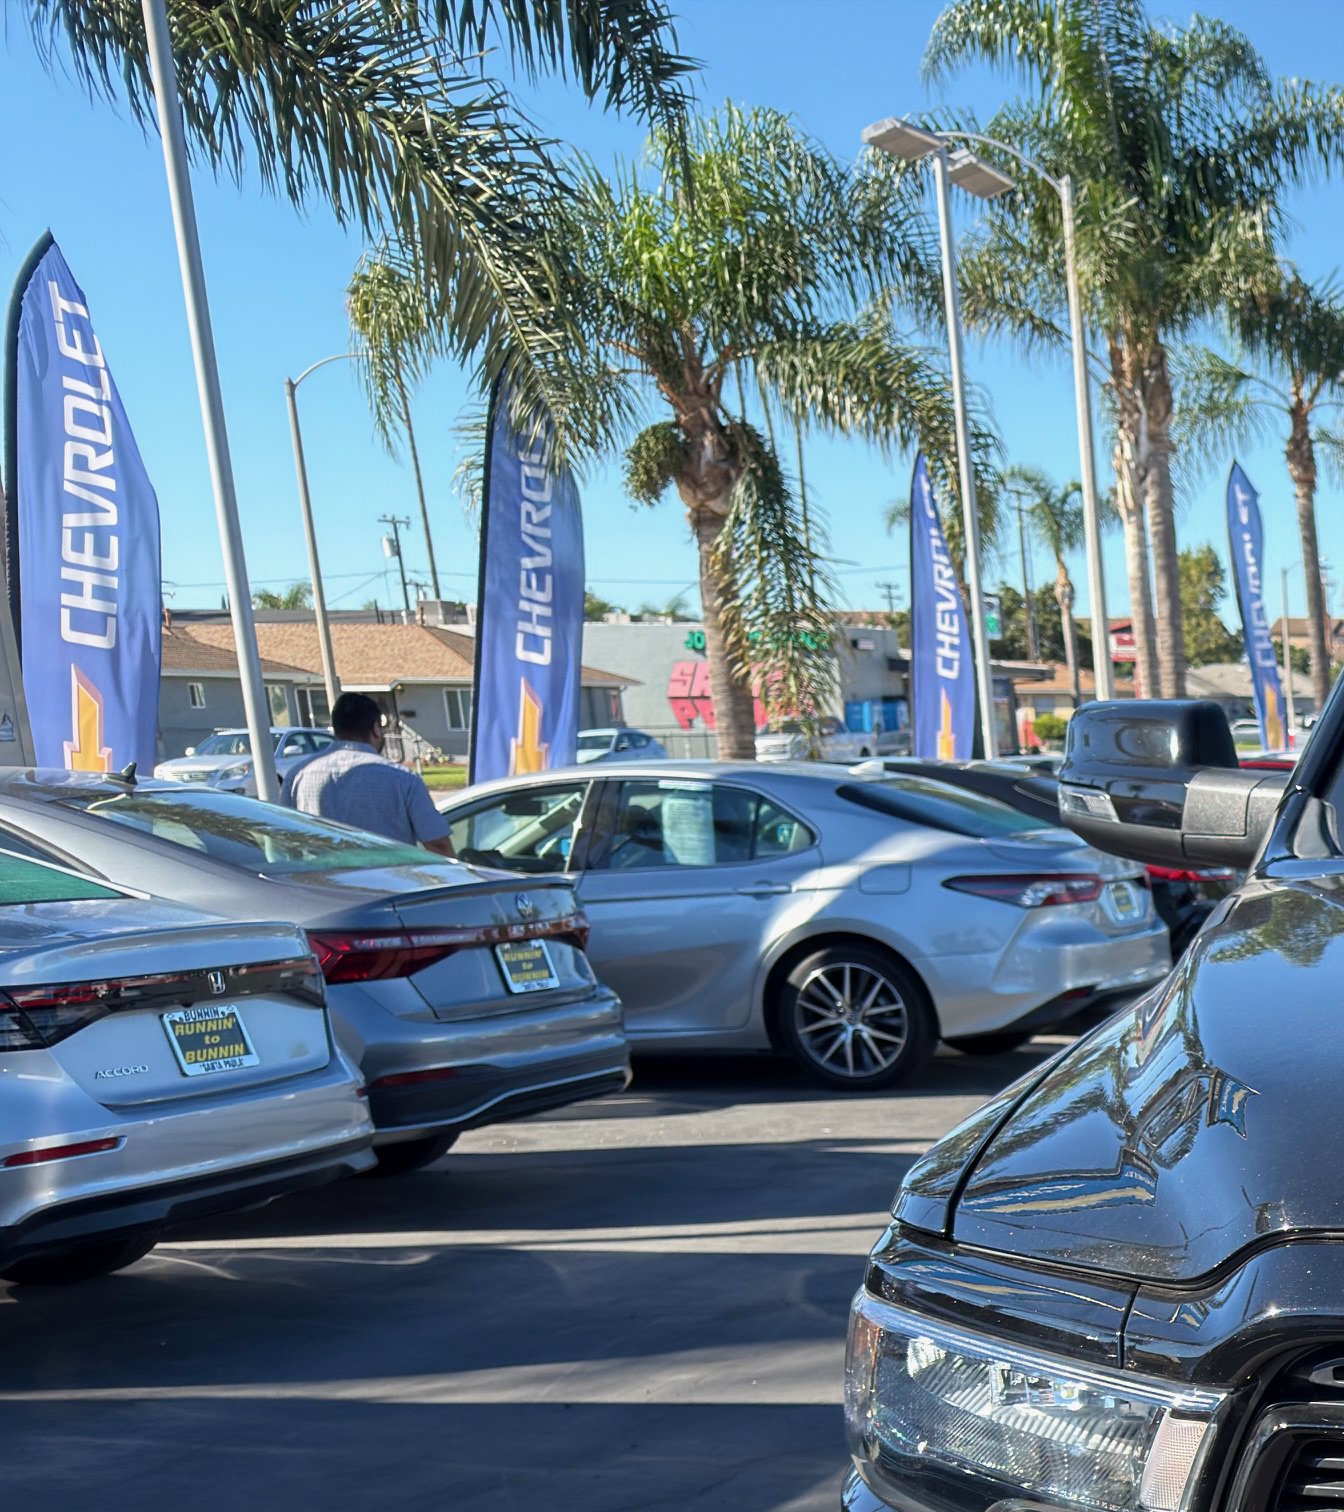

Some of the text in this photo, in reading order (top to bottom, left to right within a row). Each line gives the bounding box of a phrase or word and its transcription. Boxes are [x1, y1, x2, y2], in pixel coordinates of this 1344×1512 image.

[48, 281, 119, 649] CHEVROLET
[512, 395, 553, 666] CHEVROLE
[920, 473, 960, 680] CHEVROET
[184, 1008, 219, 1021] BUNNIN
[175, 1018, 236, 1036] RUNNIN'
[204, 1035, 220, 1045] to
[185, 1043, 244, 1064] BUNNIN
[95, 1065, 149, 1079] ACCORD
